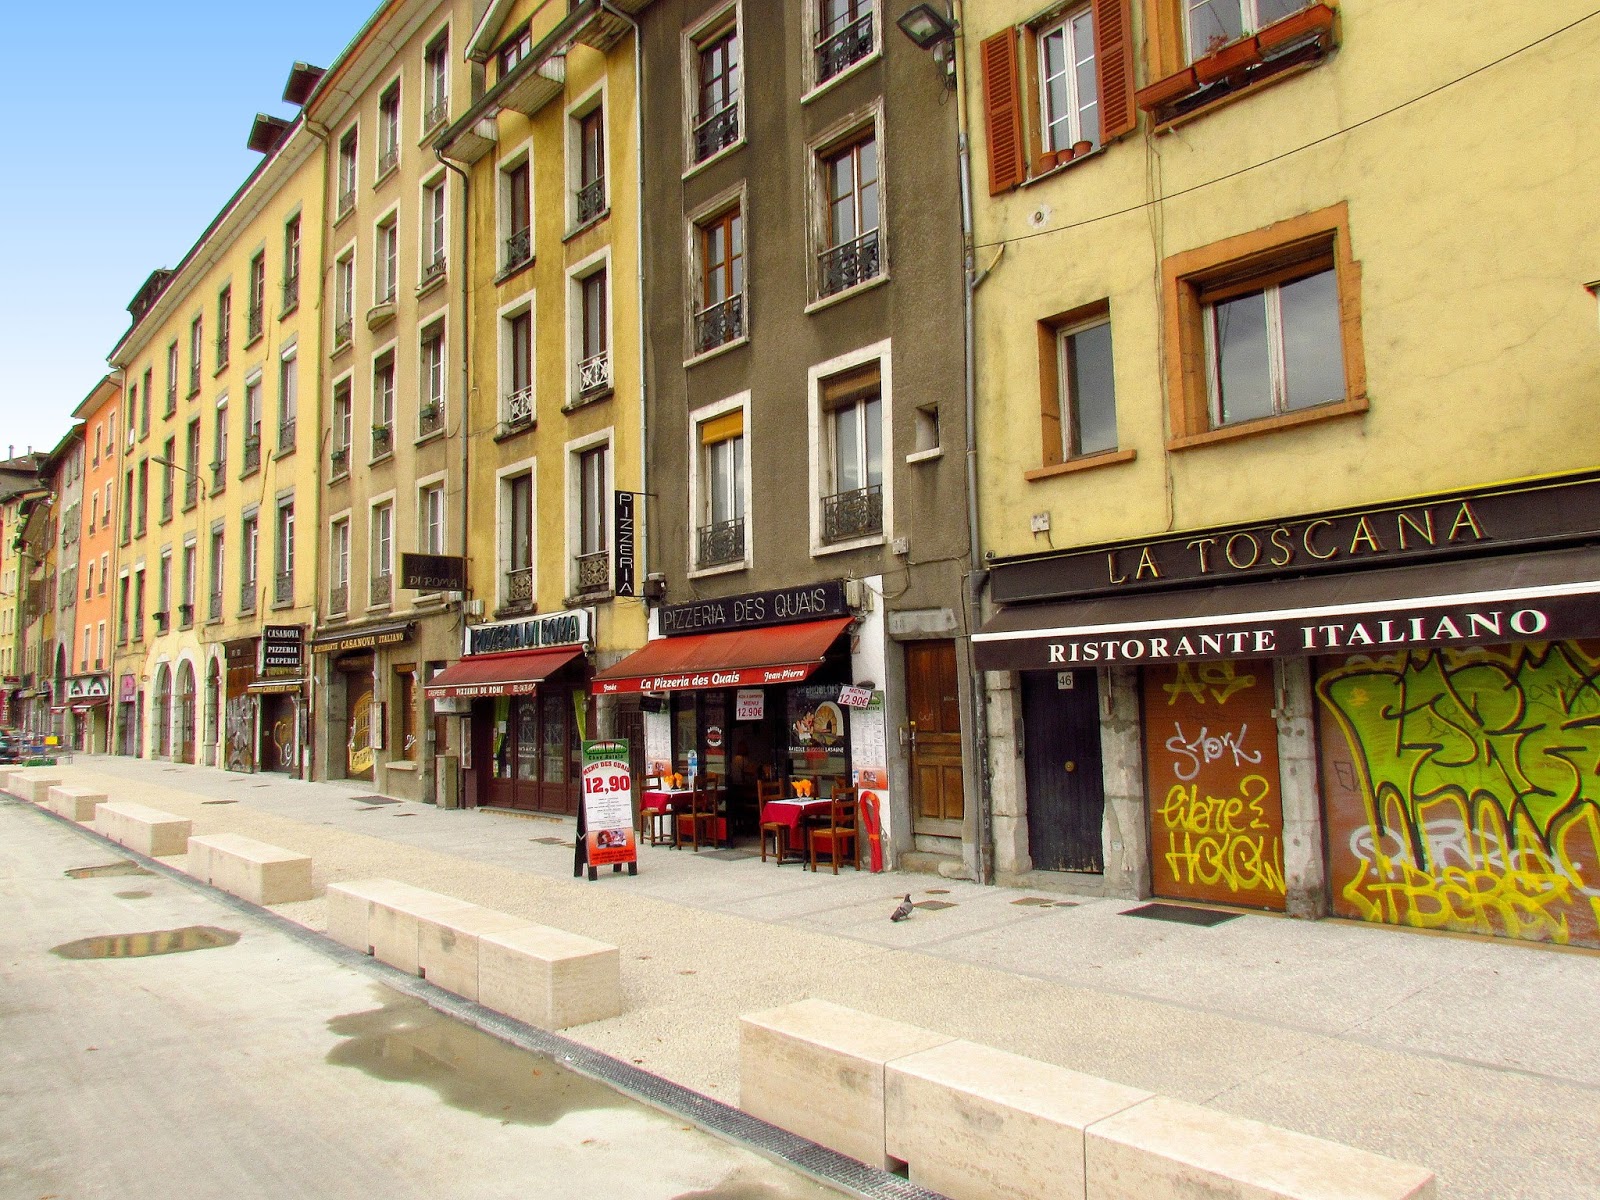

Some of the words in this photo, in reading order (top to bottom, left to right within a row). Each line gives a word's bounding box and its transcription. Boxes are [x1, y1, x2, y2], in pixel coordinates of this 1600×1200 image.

[619, 492, 633, 594] PIZZERIA
[1108, 546, 1161, 584] LA
[1187, 501, 1486, 573] TOSCANA
[409, 575, 420, 585] DI
[424, 577, 458, 587] ROMA
[663, 603, 726, 630] PIZZERIA
[734, 597, 765, 622] DES
[774, 588, 826, 617] QUAIS
[267, 629, 299, 638] CASANOVA
[542, 616, 580, 645] ROMA
[1048, 629, 1276, 663] RISTORANTE
[1300, 609, 1549, 649] ITALIANO
[341, 636, 376, 650] CASANOVA
[266, 657, 299, 665] CREPERIE
[640, 679, 651, 689] La
[654, 675, 689, 690] Pizzeria
[692, 675, 709, 686] des
[712, 671, 740, 685] Quais
[764, 668, 805, 682] Jean-Pierre
[1058, 675, 1073, 686] 46
[848, 687, 867, 696] MENU
[583, 763, 600, 775] MENU
[601, 760, 612, 768] DES
[613, 761, 630, 773] QUAIS
[585, 775, 631, 795] 12,90
